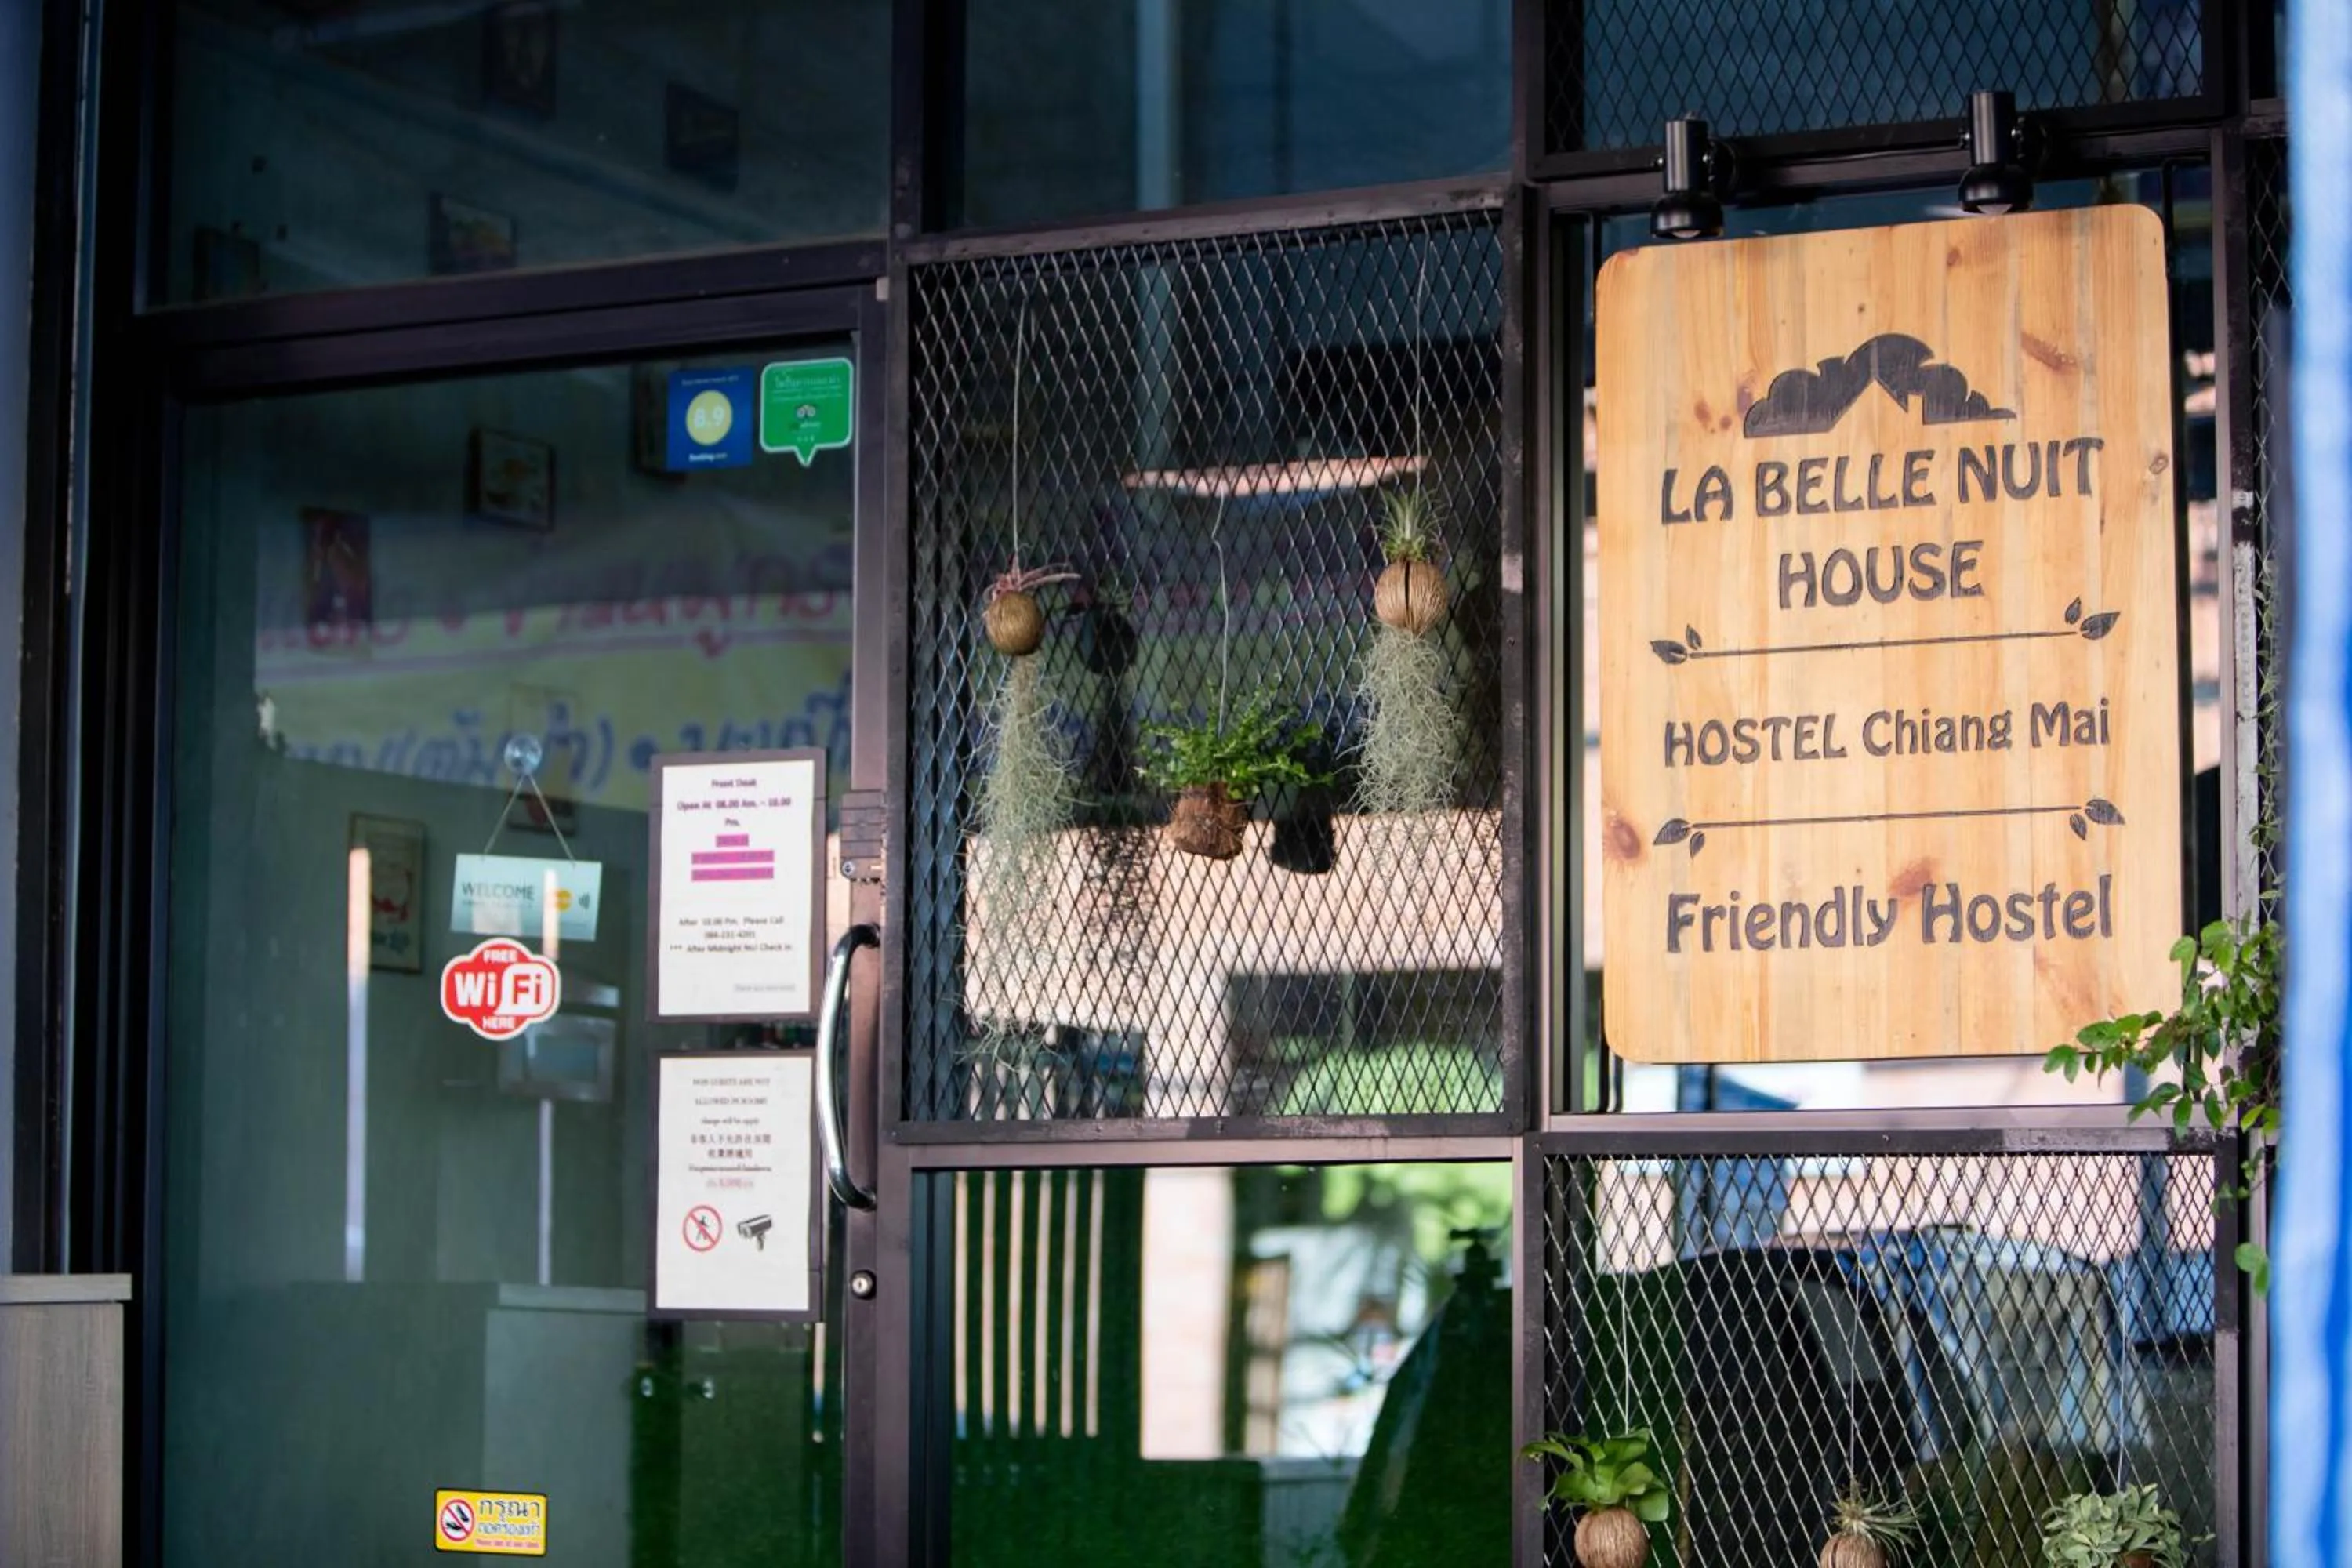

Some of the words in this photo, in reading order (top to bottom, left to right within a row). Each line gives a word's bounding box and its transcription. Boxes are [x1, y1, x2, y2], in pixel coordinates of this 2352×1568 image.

[694, 406, 724, 429] 8.9
[1661, 464, 1733, 525] LA
[1755, 449, 1936, 517] BELLE
[1958, 437, 2104, 504] NUIT
[1779, 540, 1984, 609] HOUSE
[1664, 713, 1848, 768] HOSTEL
[1862, 707, 2013, 757] Chiang
[2030, 697, 2111, 749] Mai
[677, 801, 699, 811] Open
[462, 881, 535, 901] WELCOME
[1667, 885, 1898, 953] Friendly
[1922, 873, 2113, 944] Hostel
[483, 949, 518, 963] FREE
[482, 1016, 515, 1029] HERE
[480, 1499, 540, 1522] กรุณา
